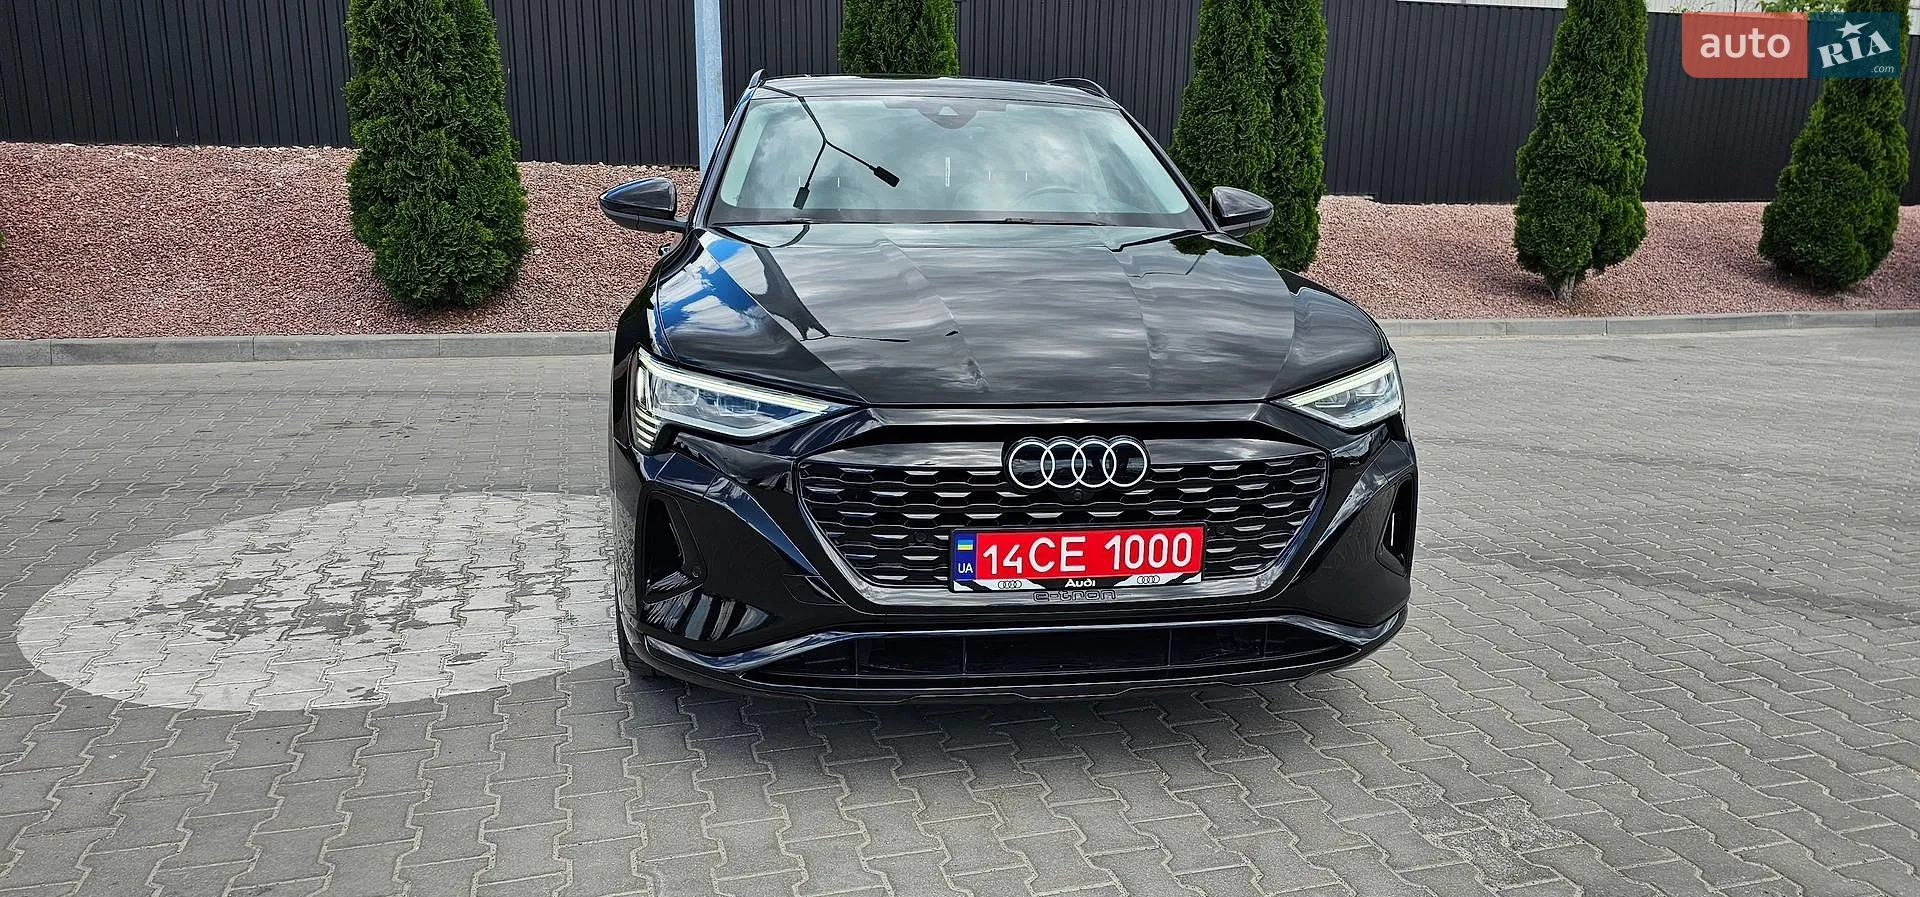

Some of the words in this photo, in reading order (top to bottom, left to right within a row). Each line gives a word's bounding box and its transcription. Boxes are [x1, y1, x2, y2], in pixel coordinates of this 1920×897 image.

[1104, 532, 1193, 570] 1000
[958, 562, 973, 574] UA
[1064, 578, 1096, 588] Audi
[1032, 589, 1117, 602] e-tron
